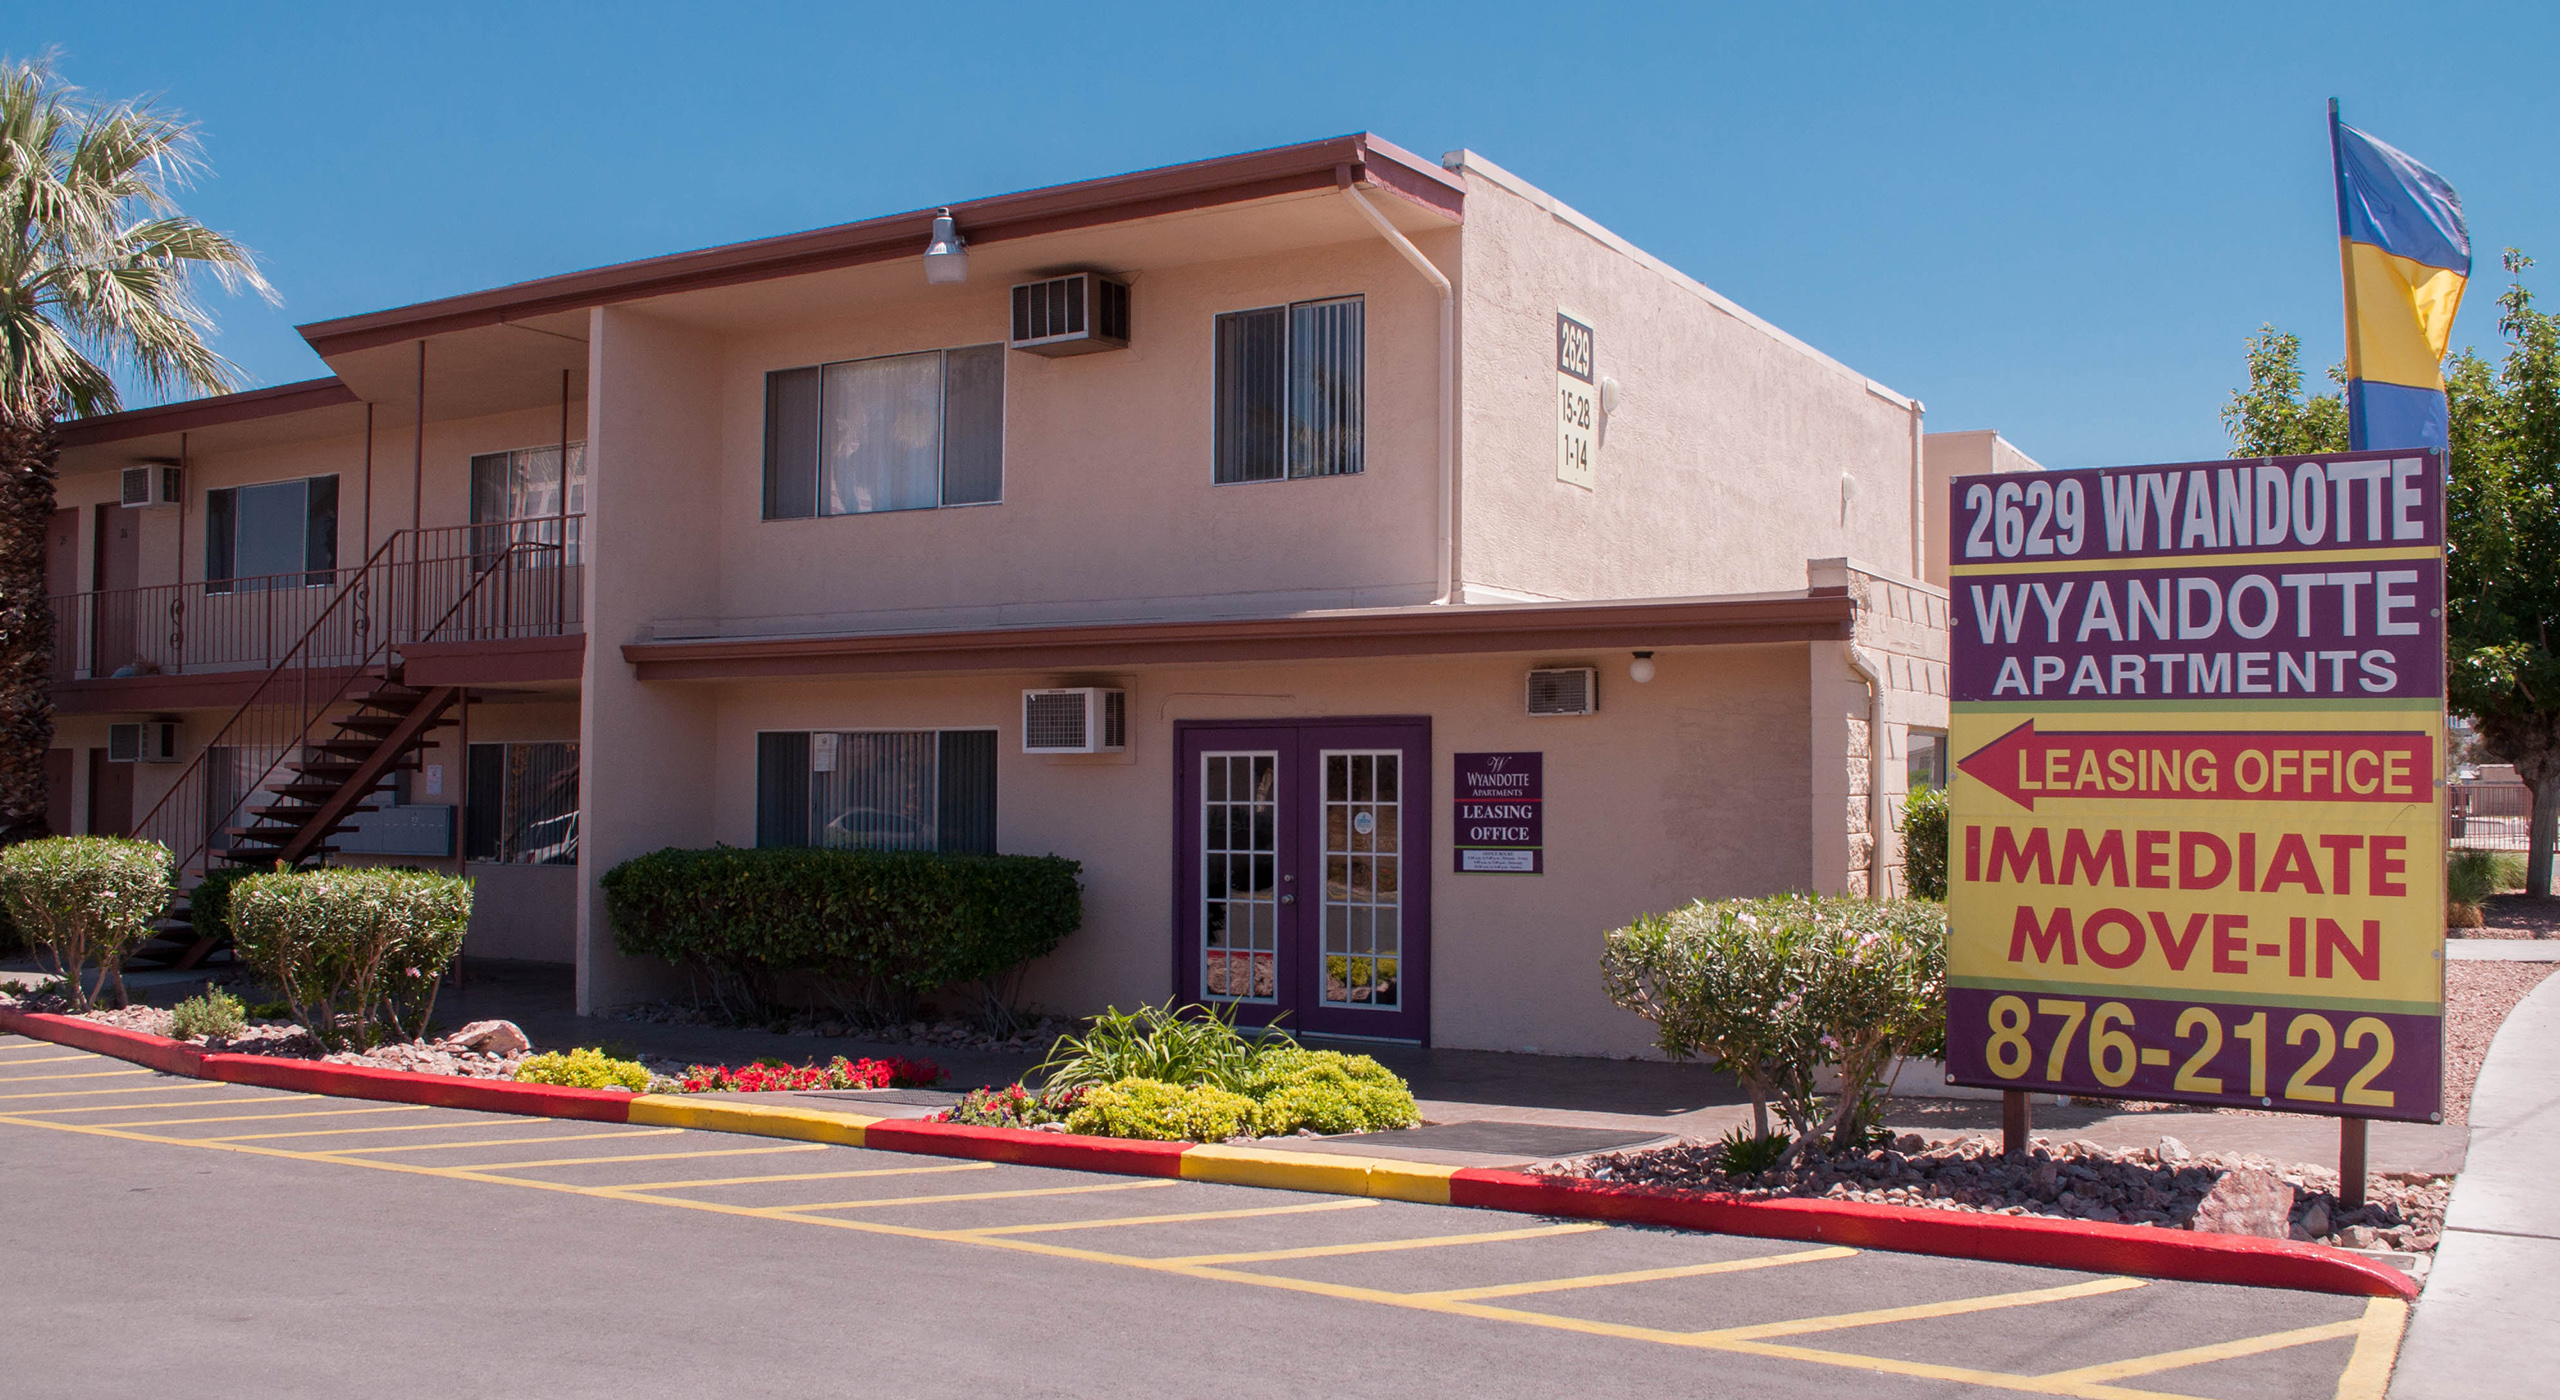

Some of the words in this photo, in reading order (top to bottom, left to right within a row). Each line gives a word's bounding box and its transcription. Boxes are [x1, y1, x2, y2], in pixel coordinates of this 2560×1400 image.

[1562, 321, 1590, 378] 2629
[1561, 389, 1591, 430] 15-28
[1564, 434, 1588, 472] 1-14
[1964, 478, 2086, 558] 2629
[2101, 458, 2425, 552] WYANDOTTE
[1970, 569, 2420, 645] WYANDOTTE
[1992, 649, 2398, 696] APARTMENTS
[1467, 772, 1530, 787] WYANDOTTE
[1472, 789, 1523, 797] APARTMENTS
[2018, 749, 2219, 794] LEASING
[2233, 748, 2413, 795] OFFICE
[1463, 805, 1533, 819] LEASING
[1470, 826, 1530, 841] OFFICE
[1965, 825, 2407, 897] IMMEDIATE
[2008, 905, 2381, 981] MOVE-IN
[1985, 995, 2395, 1108] 876-2122
